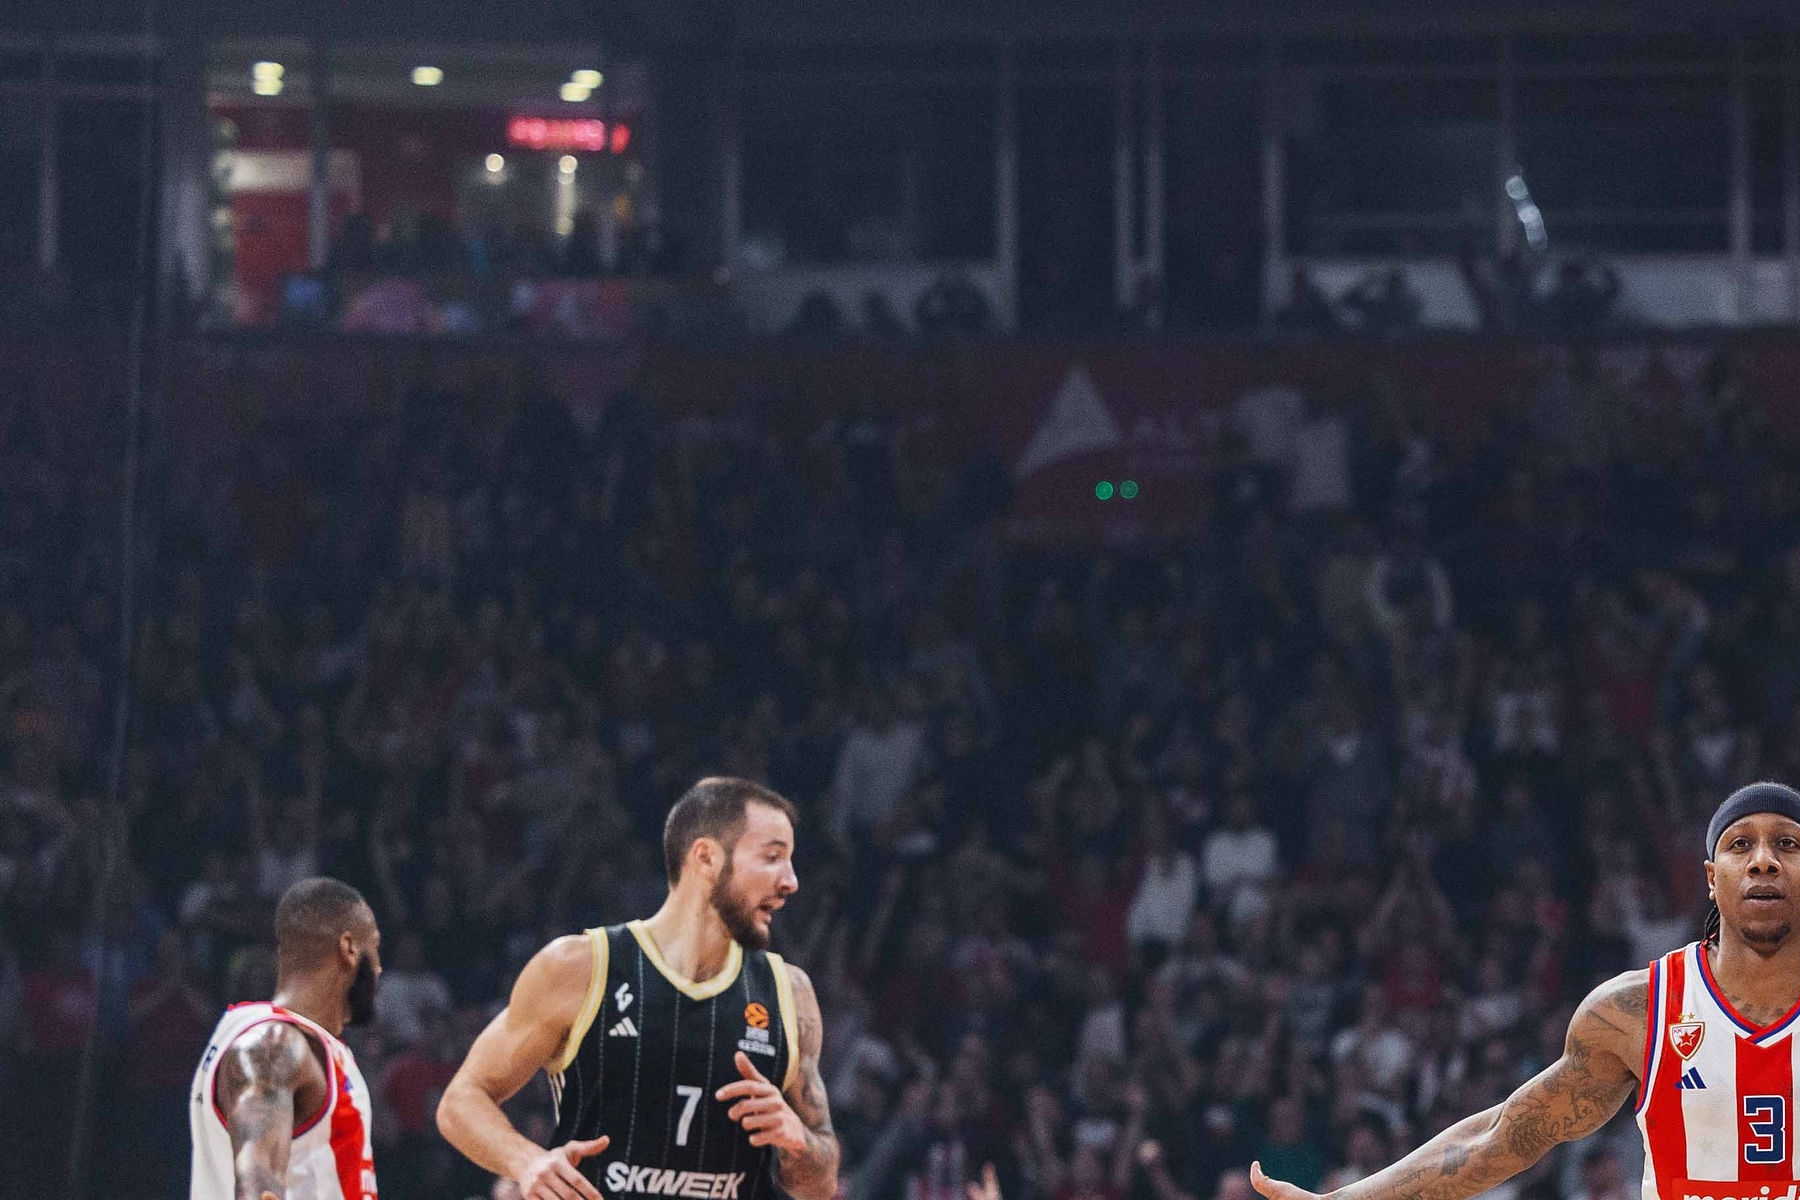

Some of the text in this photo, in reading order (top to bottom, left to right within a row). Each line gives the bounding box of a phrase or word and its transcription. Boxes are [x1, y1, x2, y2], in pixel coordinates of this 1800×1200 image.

[676, 1085, 702, 1146] 7
[1744, 1095, 1786, 1164] 3
[606, 1161, 746, 1200] SKWEEK
